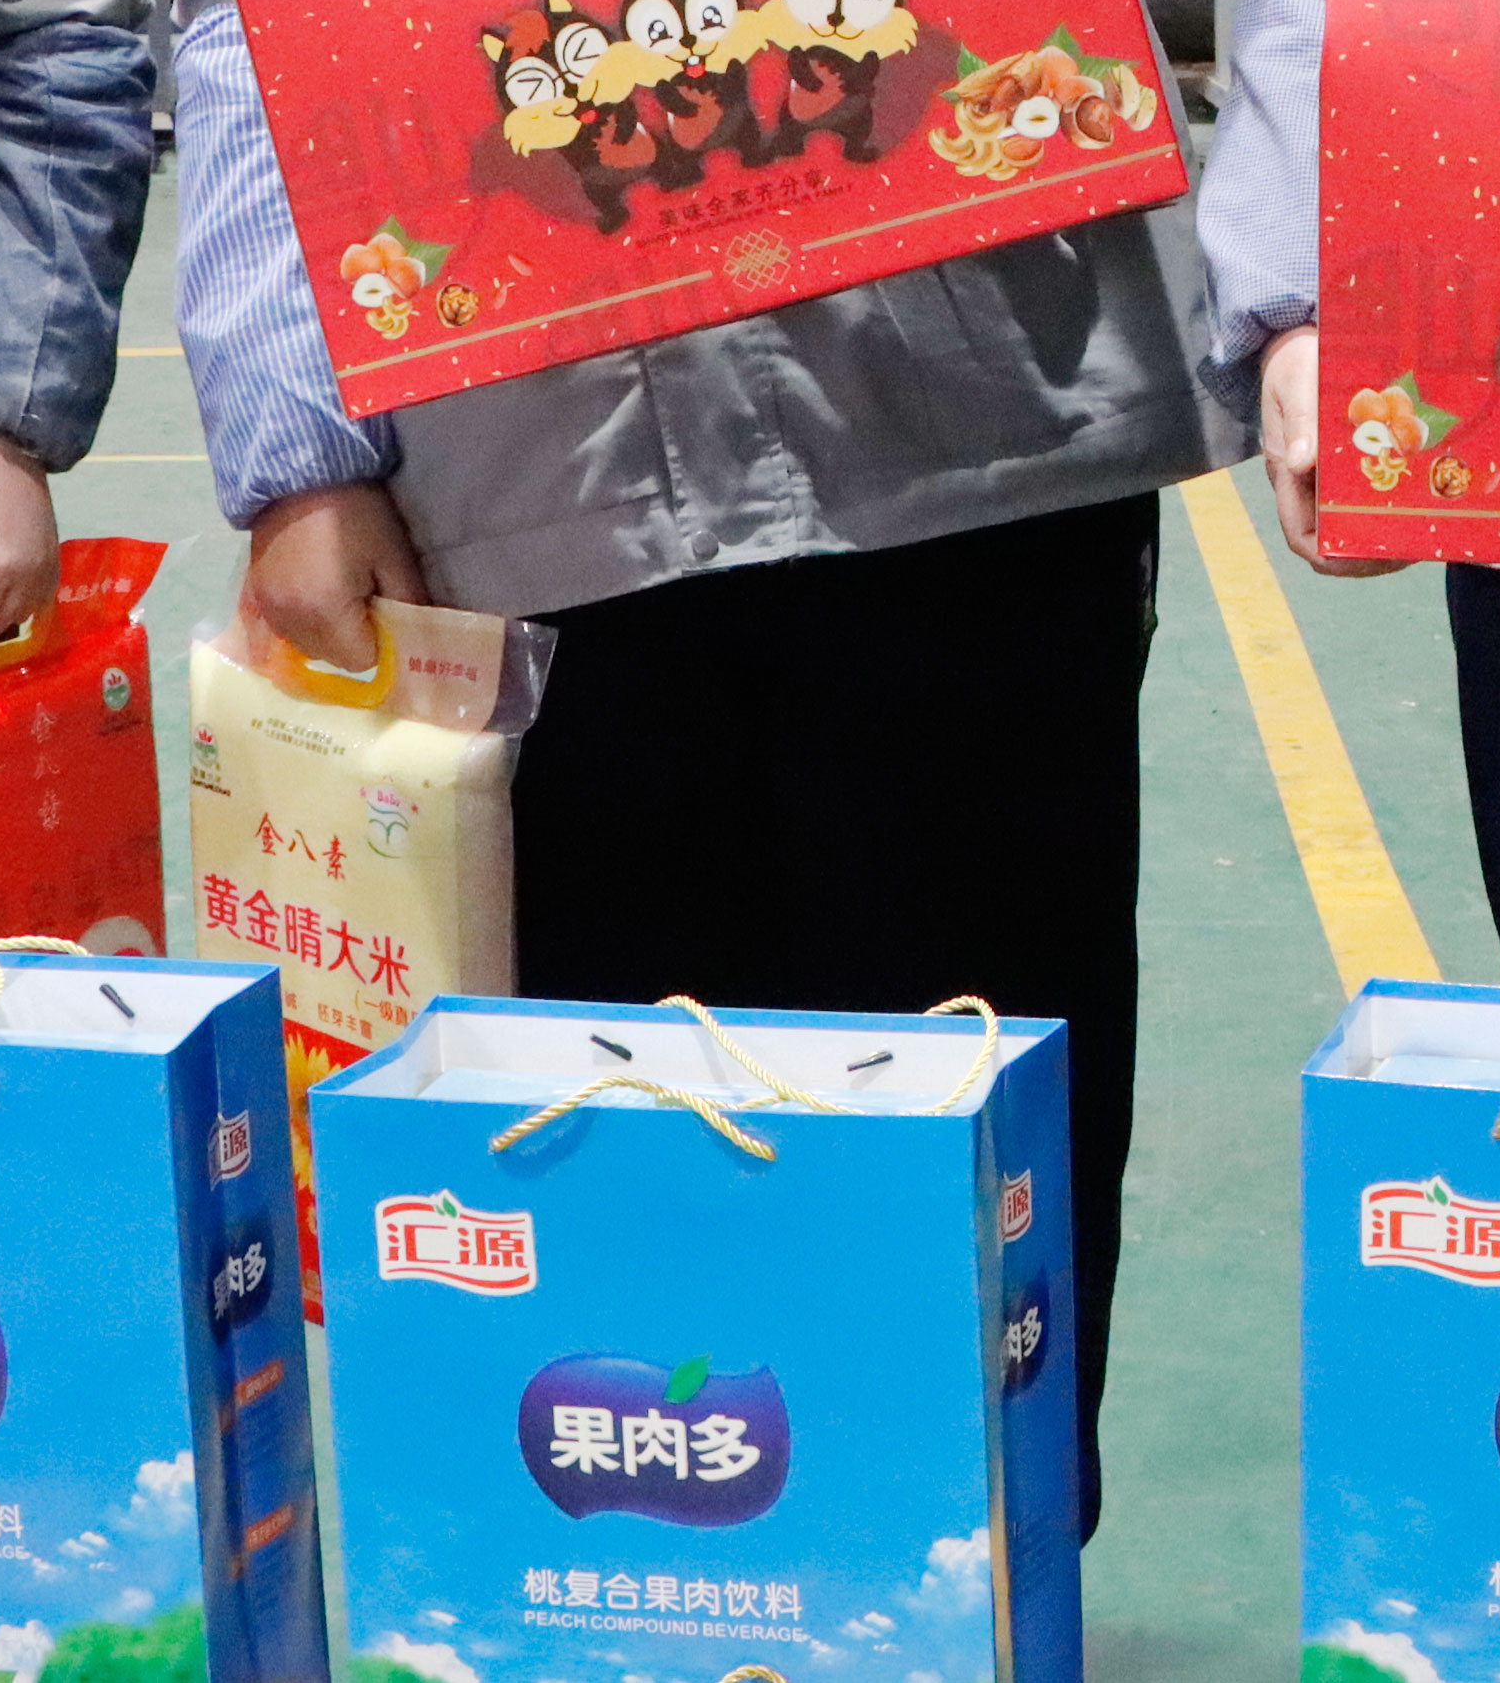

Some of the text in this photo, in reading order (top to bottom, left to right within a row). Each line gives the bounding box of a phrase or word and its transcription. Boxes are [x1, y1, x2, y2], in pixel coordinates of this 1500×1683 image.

[255, 811, 348, 882] 金八素
[203, 872, 412, 999] 黄金晴大米
[385, 1221, 526, 1269] 汇源
[1006, 1305, 1042, 1365] 肉多
[550, 1405, 762, 1482] 果肉多
[523, 1567, 803, 1623] 桃复合果肉饮料
[524, 1610, 806, 1643] PEACH COMPOUND BEVERAGE
